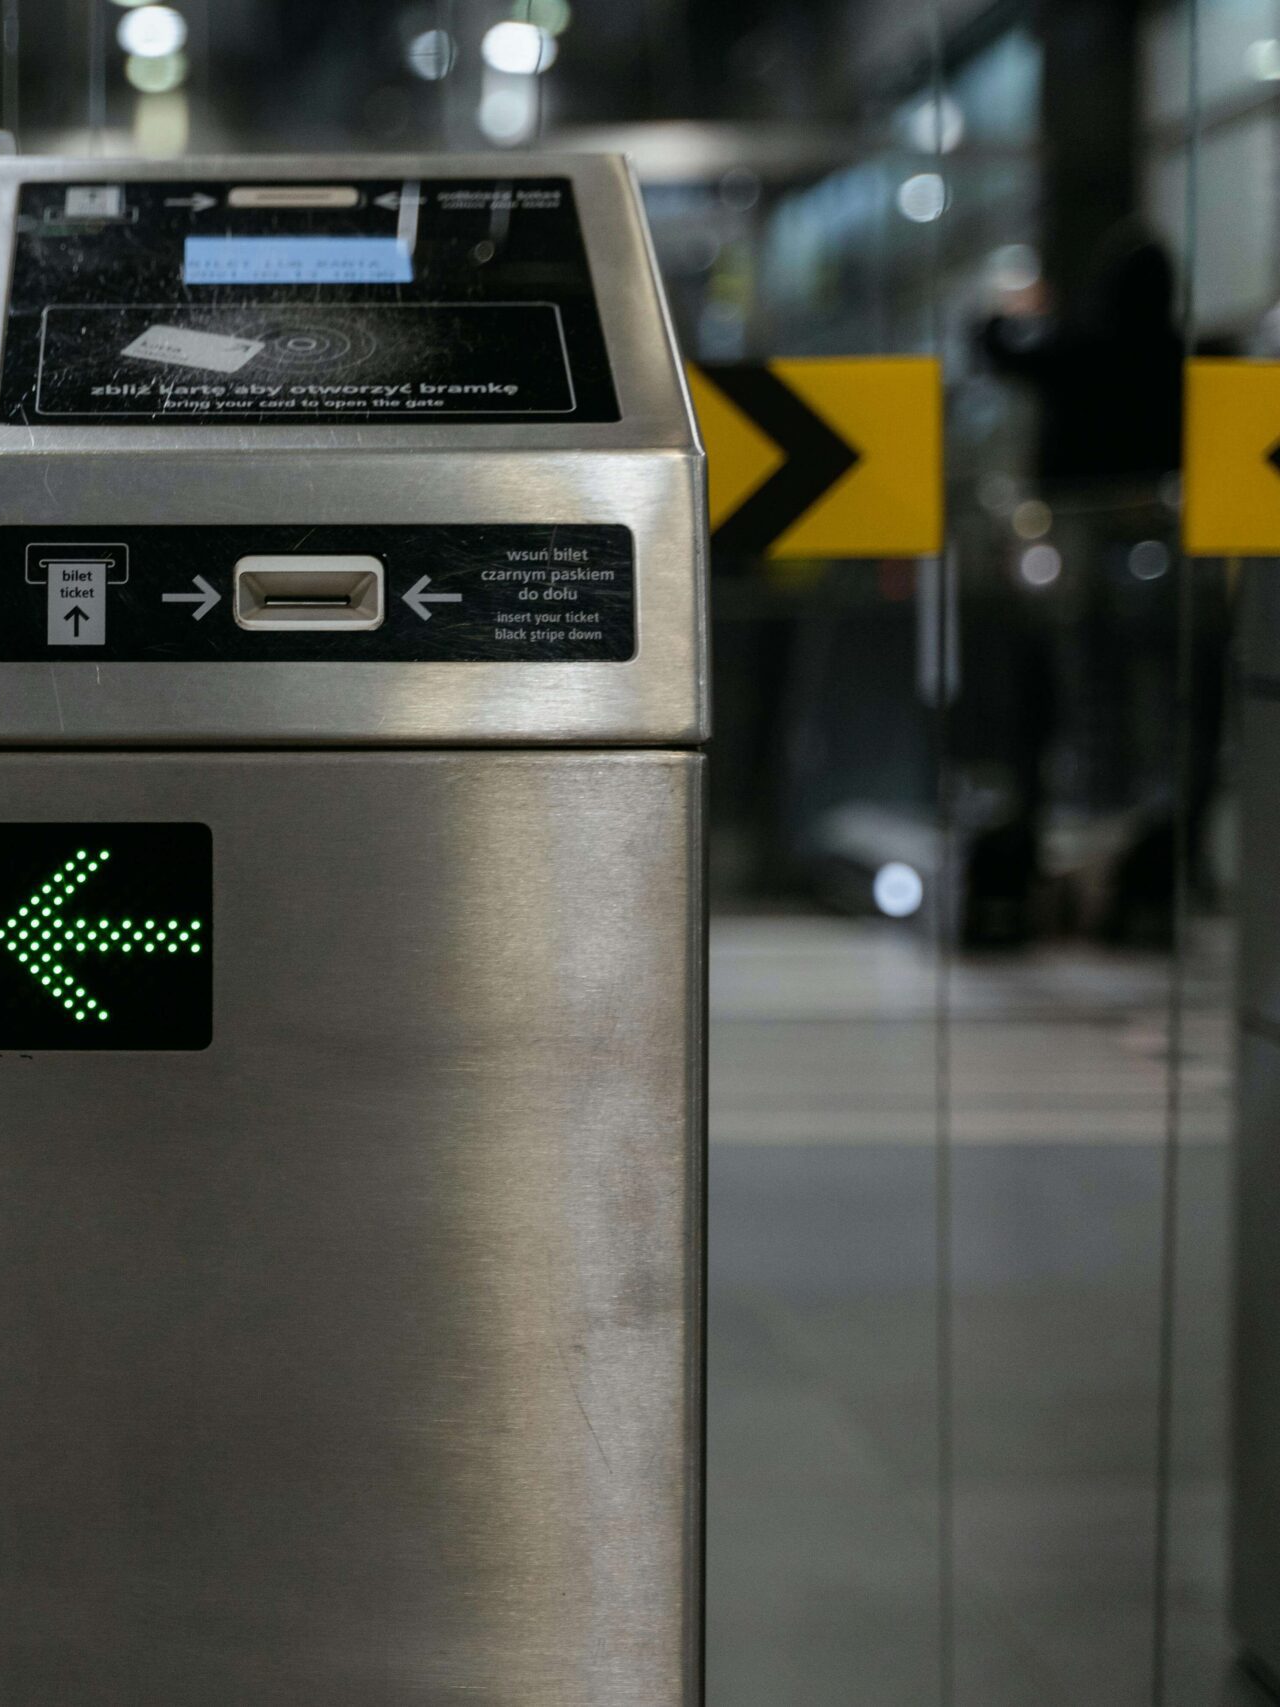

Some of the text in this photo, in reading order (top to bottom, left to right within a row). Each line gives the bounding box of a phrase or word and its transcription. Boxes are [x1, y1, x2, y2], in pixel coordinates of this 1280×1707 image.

[90, 382, 519, 397] zbliż kartę aby otworzyć bramkę
[165, 399, 445, 409] bring your card to open the gate
[506, 547, 589, 561] wsuń bilet
[62, 570, 94, 582] bilet
[480, 567, 615, 584] czarnym paskiem
[60, 586, 95, 599] ticket
[518, 587, 578, 601] do dołu
[496, 611, 600, 625] insert your ticket
[494, 628, 602, 642] black stripe down
